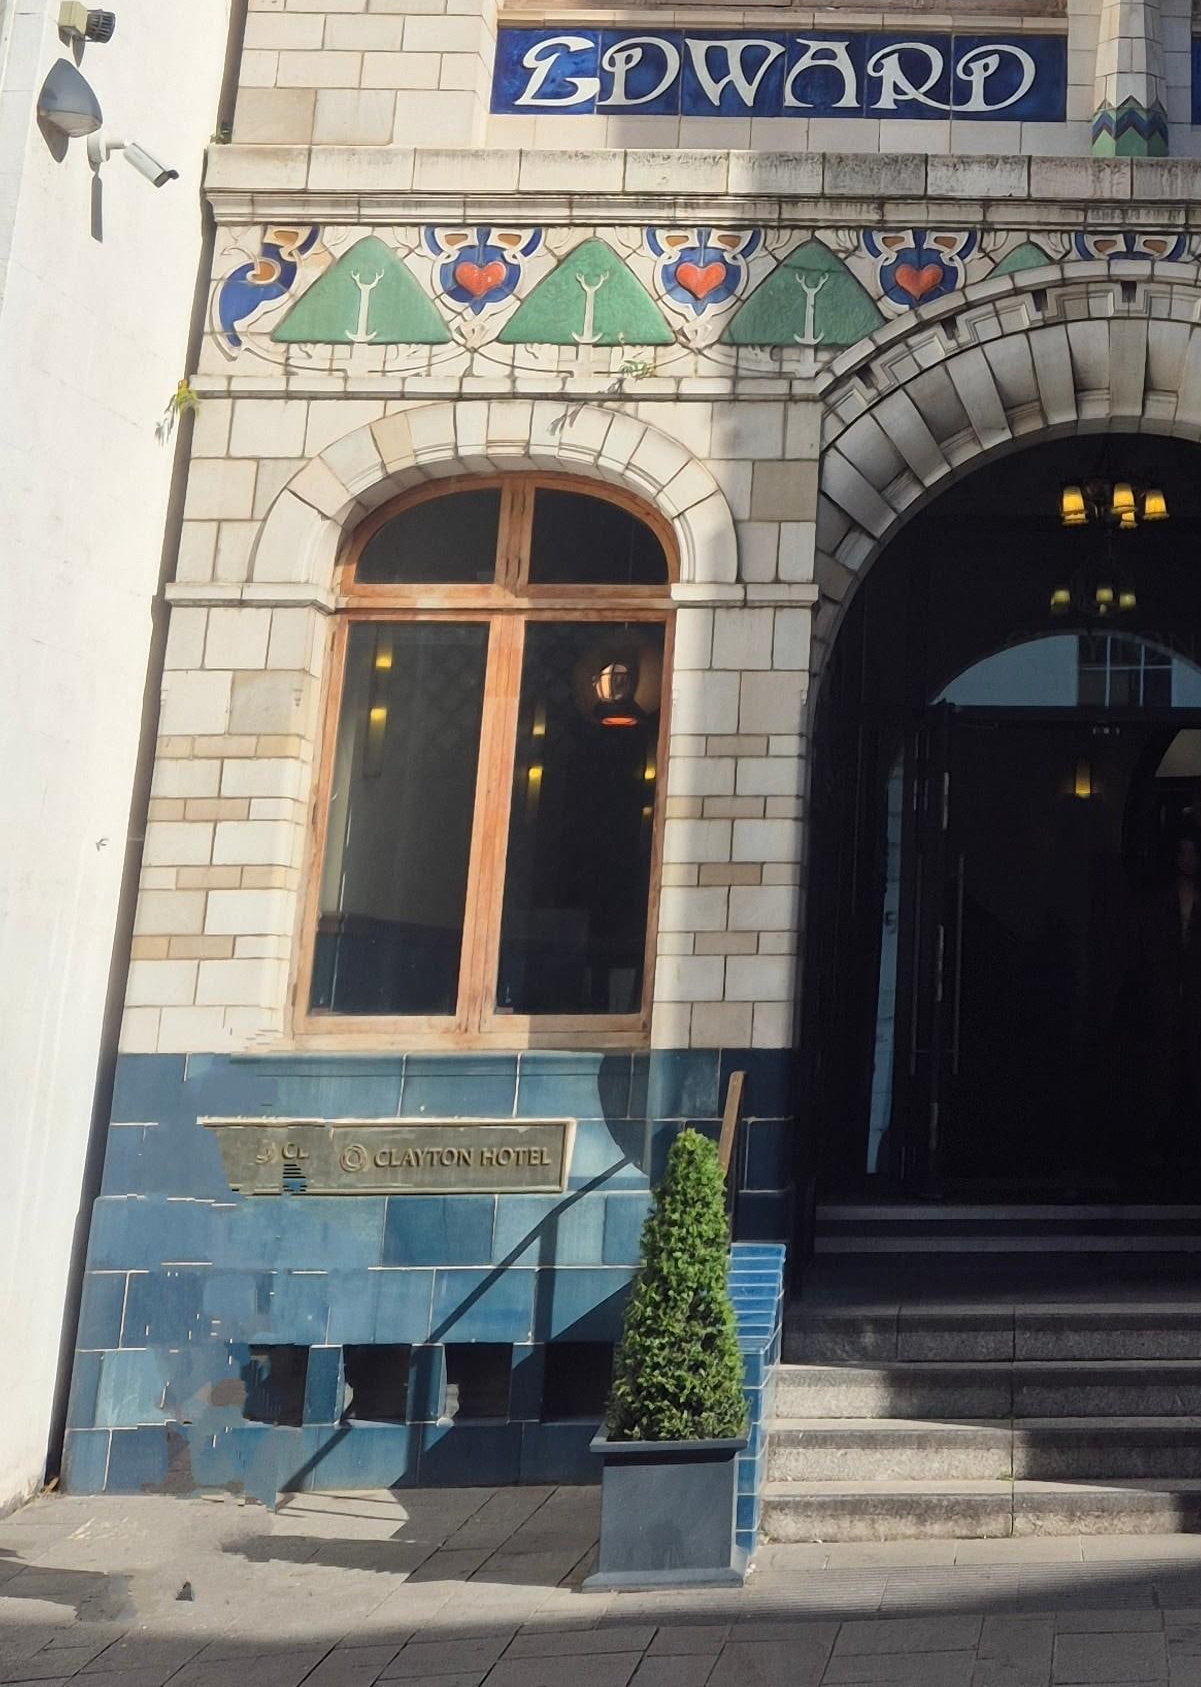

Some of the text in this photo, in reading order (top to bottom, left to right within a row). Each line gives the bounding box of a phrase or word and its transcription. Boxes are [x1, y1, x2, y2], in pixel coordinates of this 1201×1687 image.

[512, 34, 1036, 112] EDWARD
[372, 1145, 553, 1168] CLAYTON HOTEL
